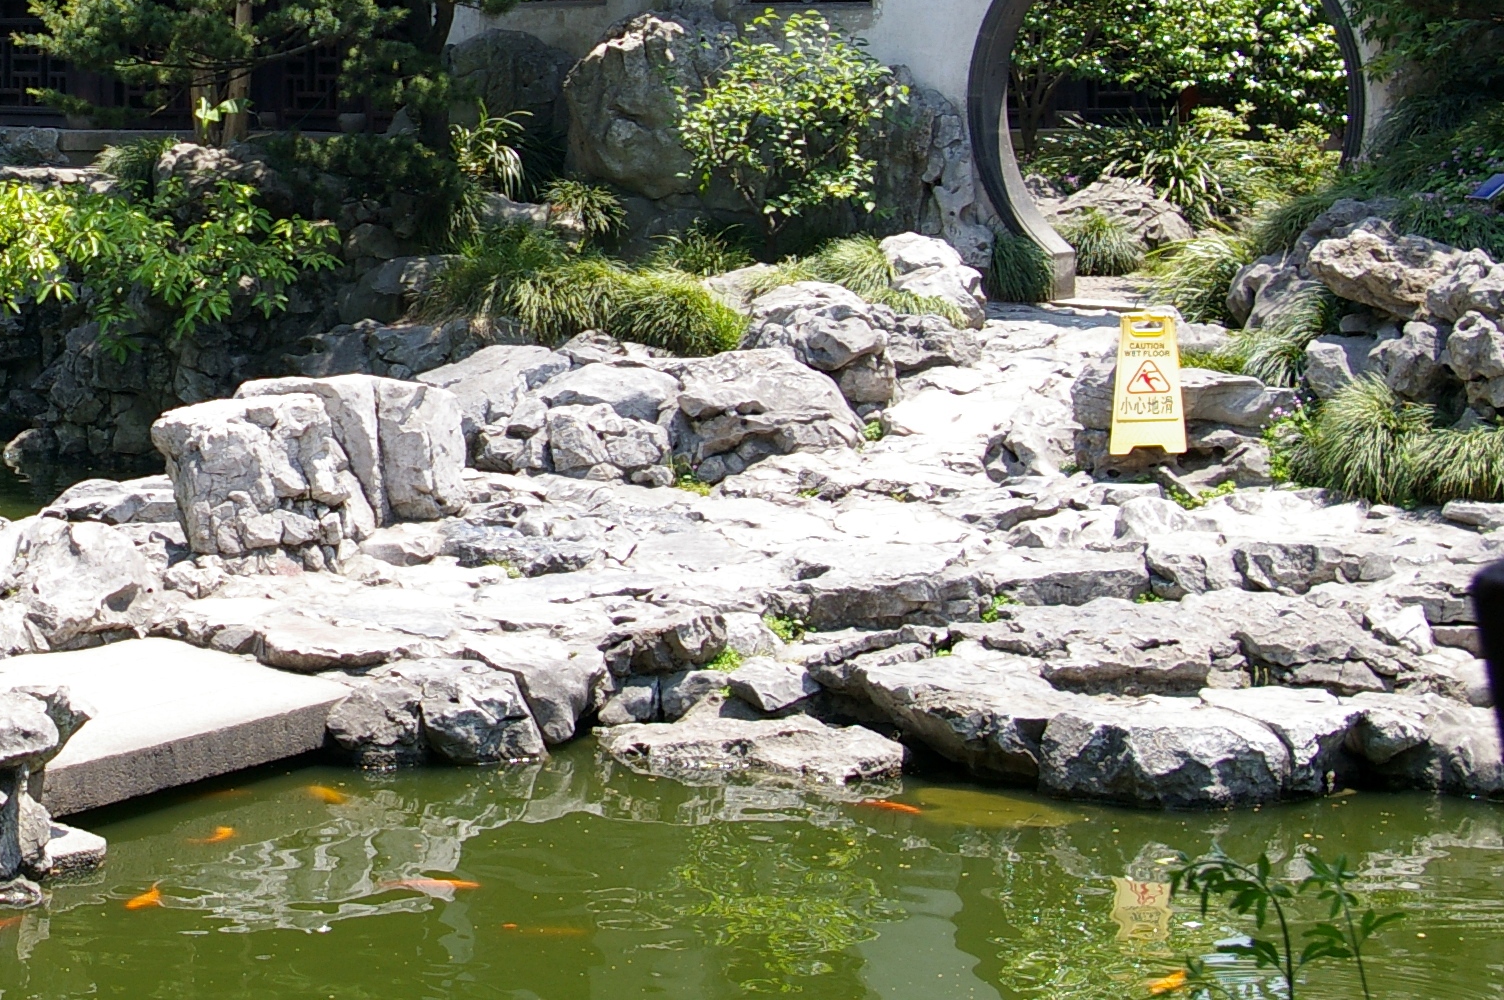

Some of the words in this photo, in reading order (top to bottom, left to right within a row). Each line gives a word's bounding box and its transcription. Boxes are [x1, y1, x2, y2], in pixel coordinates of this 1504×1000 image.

[1129, 342, 1165, 350] CAUTION
[1120, 395, 1173, 415] 小心地滑
